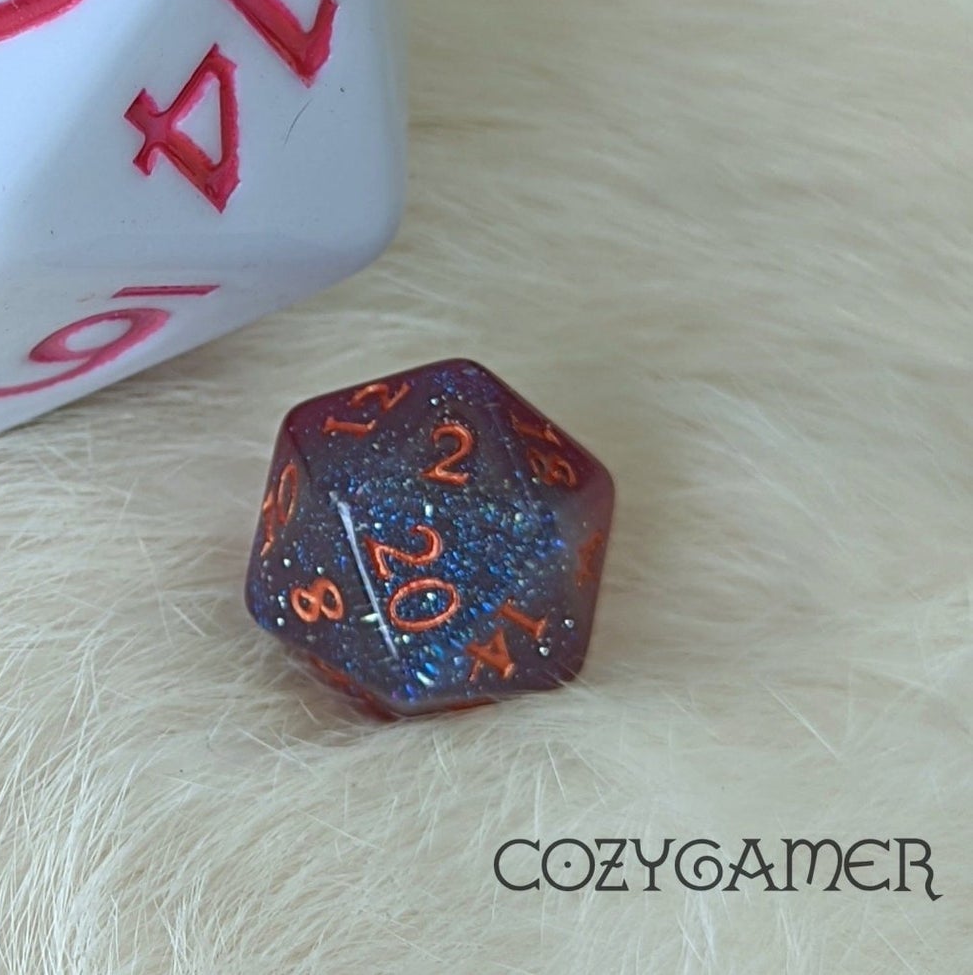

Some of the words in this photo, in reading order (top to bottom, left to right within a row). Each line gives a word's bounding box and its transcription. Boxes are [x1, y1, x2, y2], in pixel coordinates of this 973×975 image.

[322, 382, 411, 438] 12
[420, 421, 475, 487] 2
[288, 576, 345, 625] 8
[363, 524, 462, 634] 20
[463, 596, 549, 683] 14
